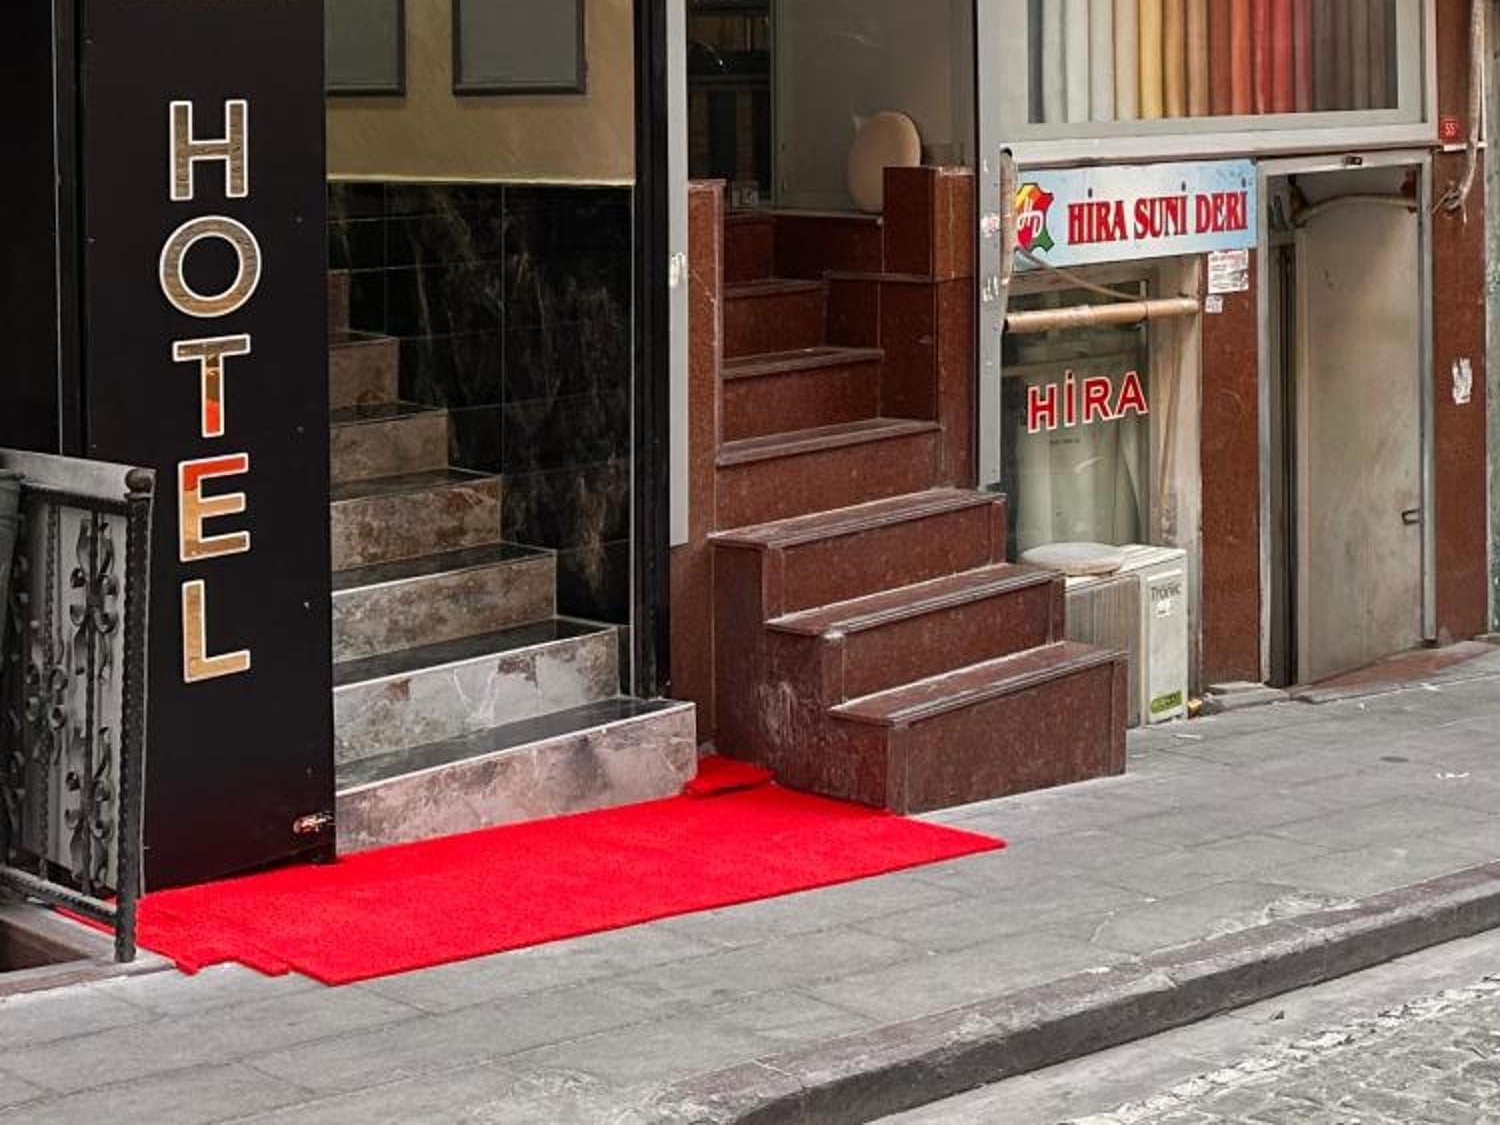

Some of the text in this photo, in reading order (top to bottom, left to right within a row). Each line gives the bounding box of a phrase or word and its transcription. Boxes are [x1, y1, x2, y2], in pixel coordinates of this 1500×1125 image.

[1068, 177, 1249, 245] HİRA SUNİ DERİ
[160, 99, 262, 683] HOTEL
[1028, 369, 1149, 434] HİRA
